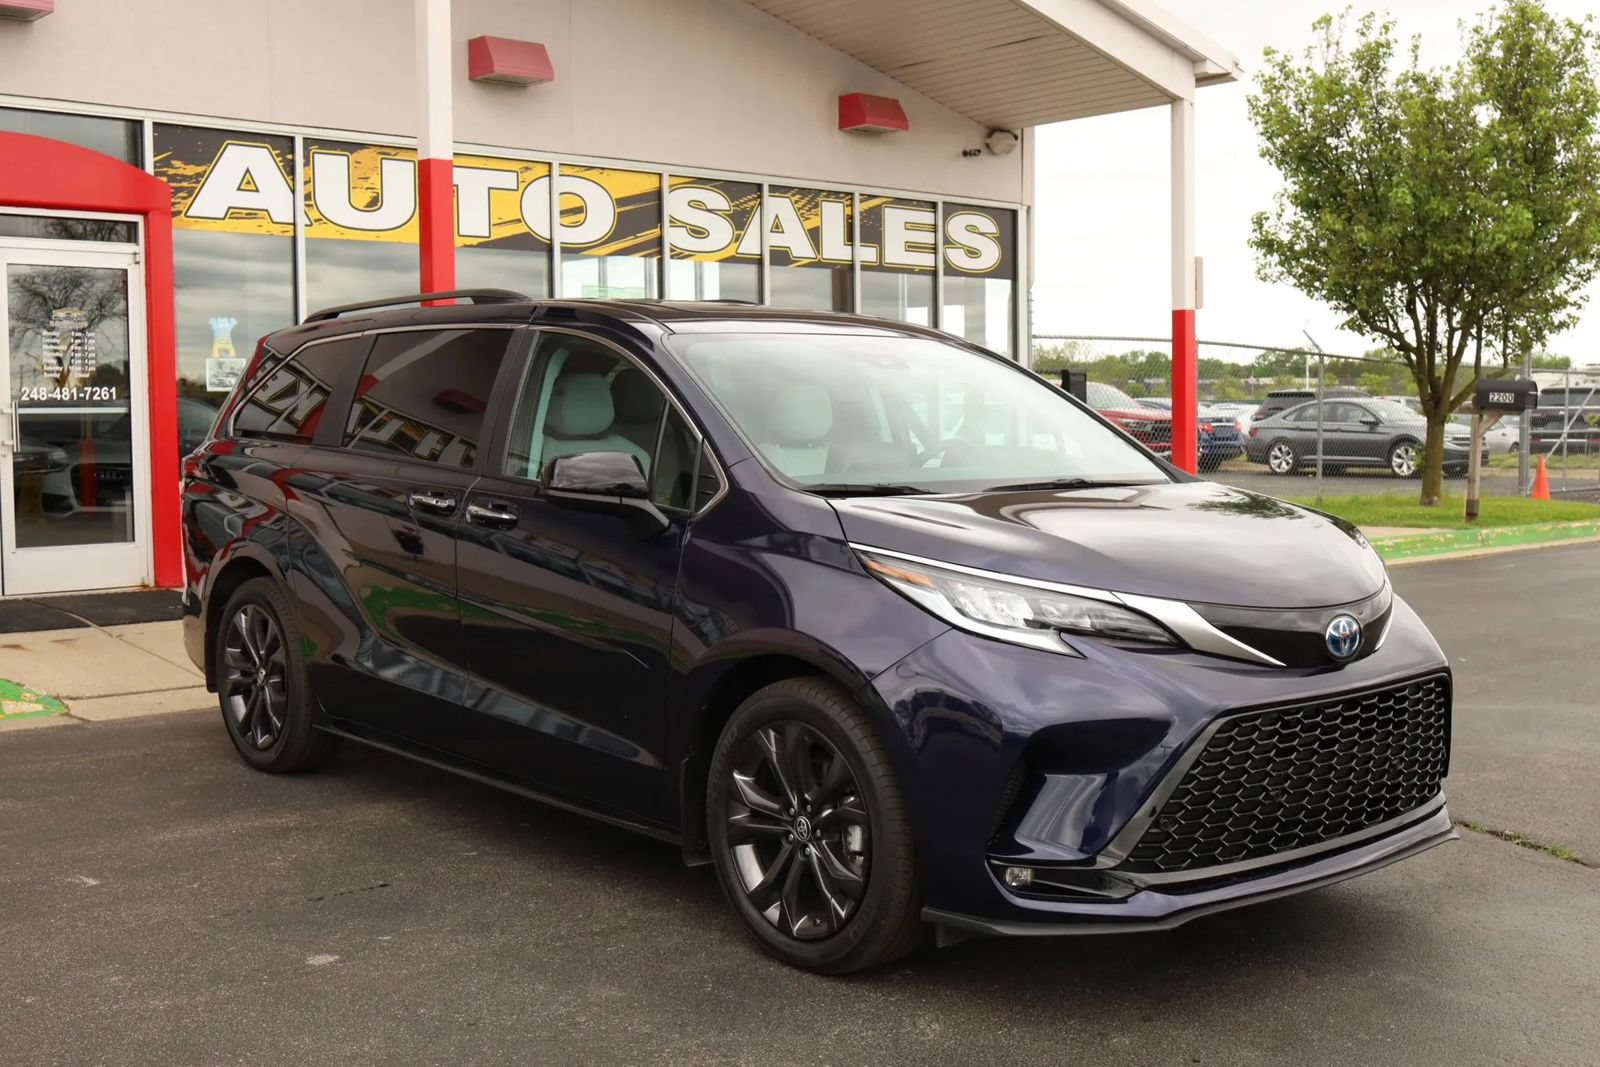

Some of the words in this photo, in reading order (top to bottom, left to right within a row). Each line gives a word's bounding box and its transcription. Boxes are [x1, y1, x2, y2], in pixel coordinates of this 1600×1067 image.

[183, 140, 616, 246] AUTO
[668, 183, 1002, 273] SALES
[20, 386, 117, 401] 248-481-7261
[1490, 393, 1513, 402] 2200
